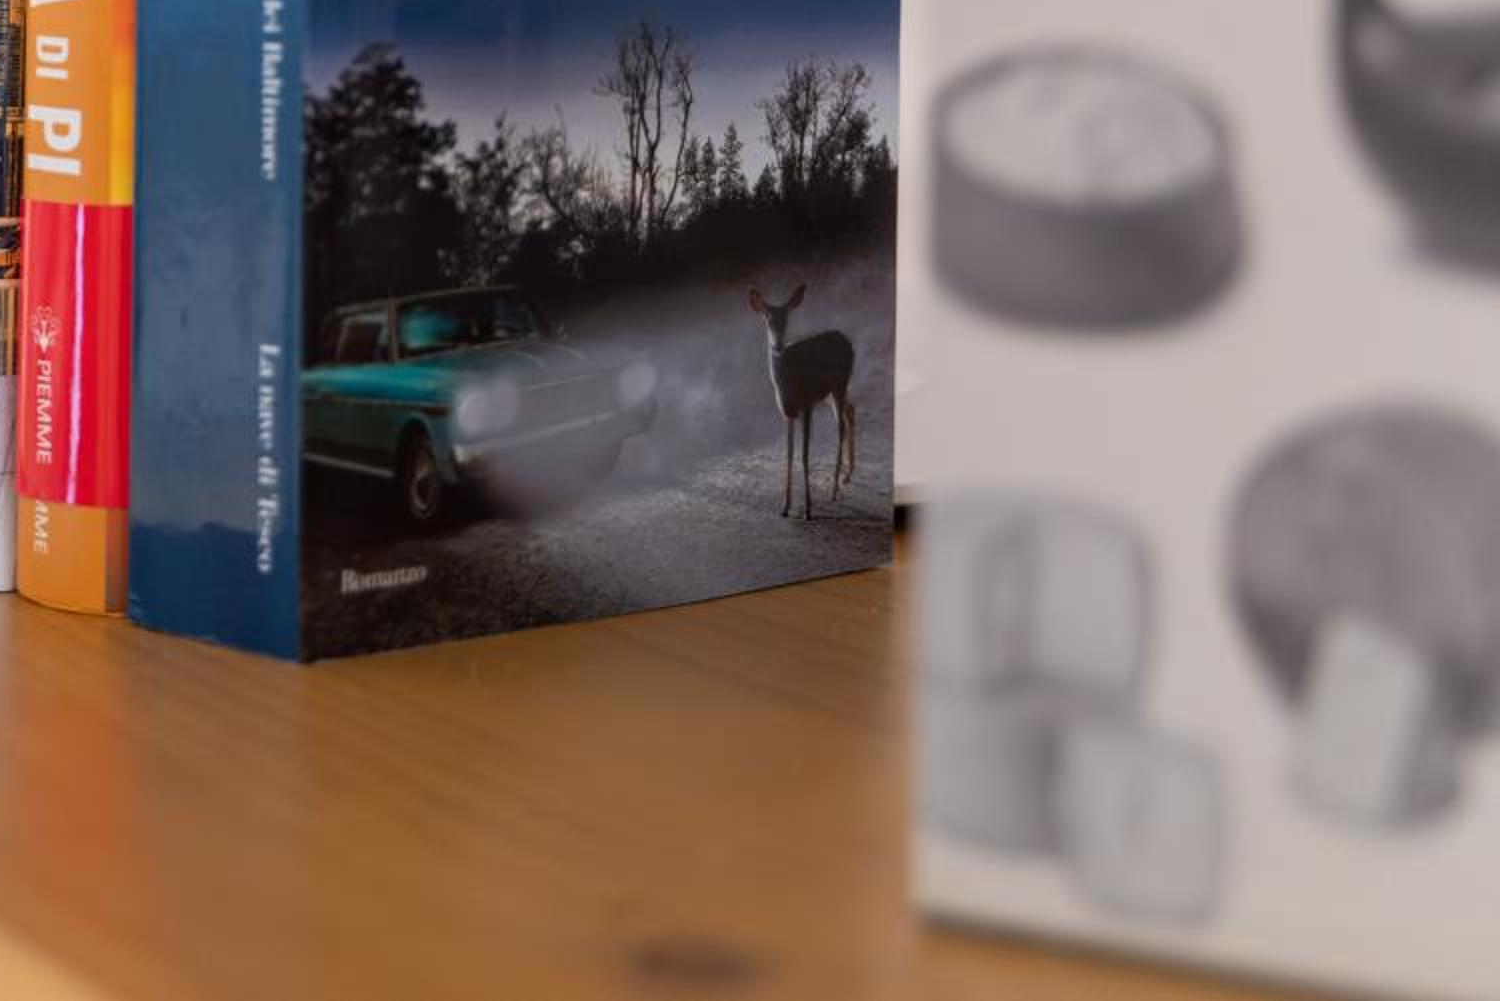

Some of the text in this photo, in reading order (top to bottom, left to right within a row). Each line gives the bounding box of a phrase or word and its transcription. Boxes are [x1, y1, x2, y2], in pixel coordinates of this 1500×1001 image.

[35, 36, 69, 80] DI
[27, 104, 83, 176] PI
[261, 41, 284, 181] Baltimore
[36, 359, 54, 465] PIEMME
[256, 343, 281, 574] La nave di Teseo
[340, 566, 429, 595] Romanzo
